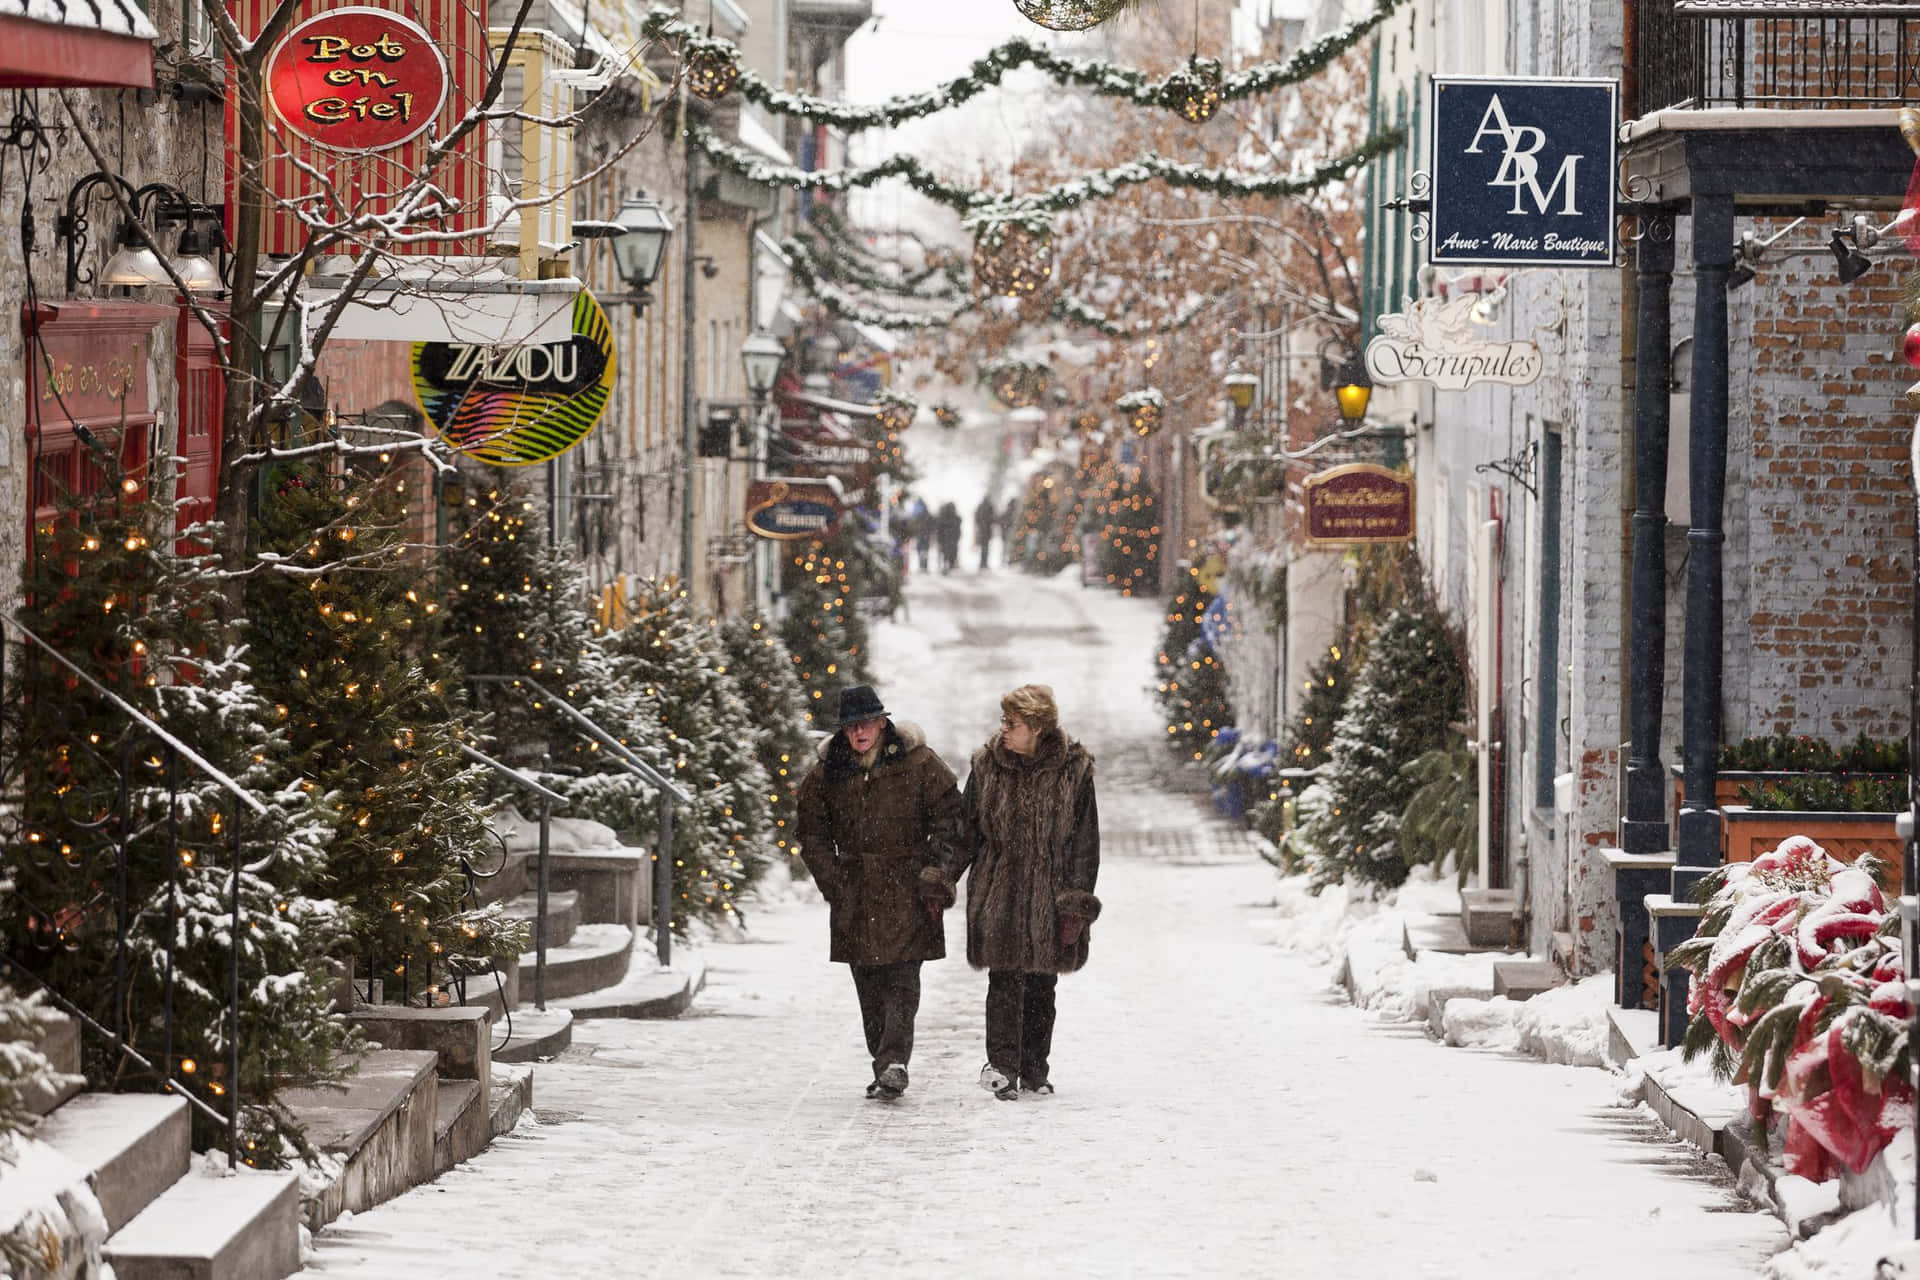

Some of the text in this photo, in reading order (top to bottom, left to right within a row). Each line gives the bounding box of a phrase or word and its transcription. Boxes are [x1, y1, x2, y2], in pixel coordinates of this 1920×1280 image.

[302, 33, 406, 62] Pot
[324, 68, 400, 88] en
[303, 92, 413, 124] Ciel
[1543, 233, 1604, 257] Boutique
[445, 344, 577, 383] ZAZOU
[1373, 344, 1535, 388] Scrupules
